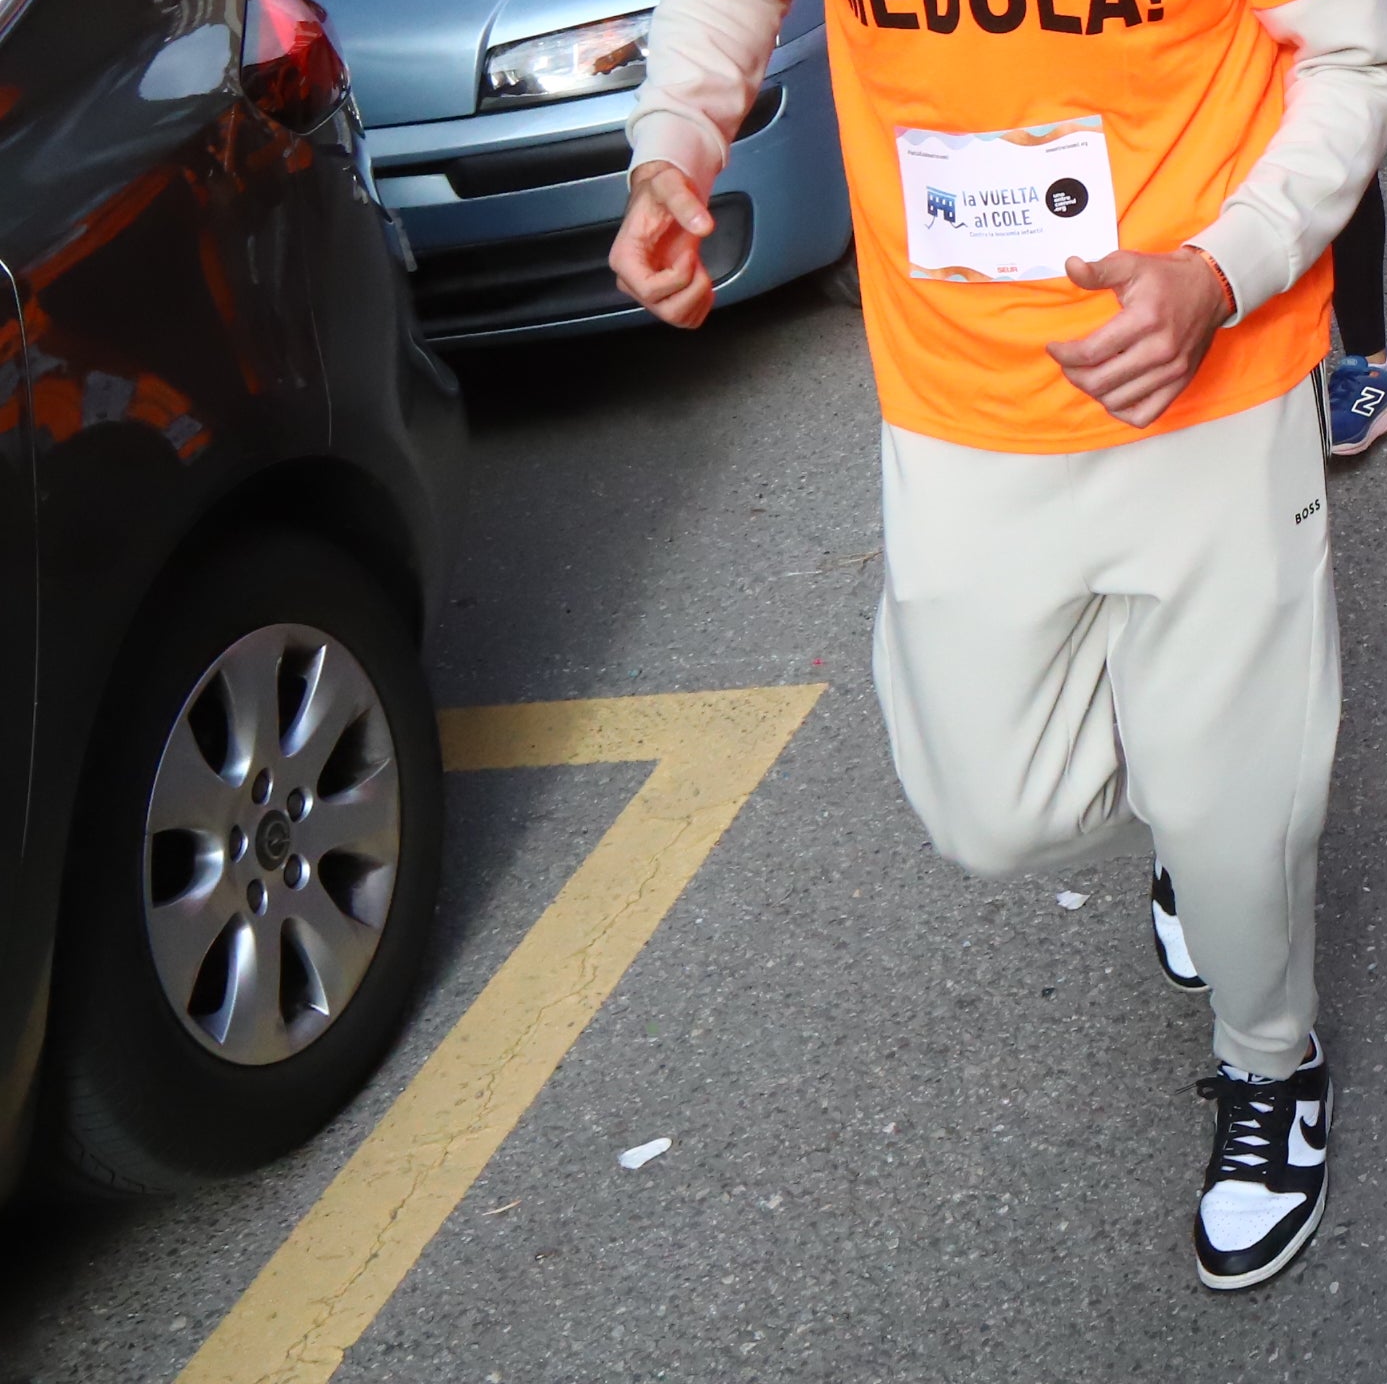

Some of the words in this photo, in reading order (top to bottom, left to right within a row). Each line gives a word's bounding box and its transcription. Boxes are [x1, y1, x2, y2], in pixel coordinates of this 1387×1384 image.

[962, 191, 976, 207] la
[979, 186, 1039, 206] VUELTA
[975, 213, 988, 228] al
[993, 209, 1032, 227] COLE
[1295, 499, 1321, 525] BOSS
